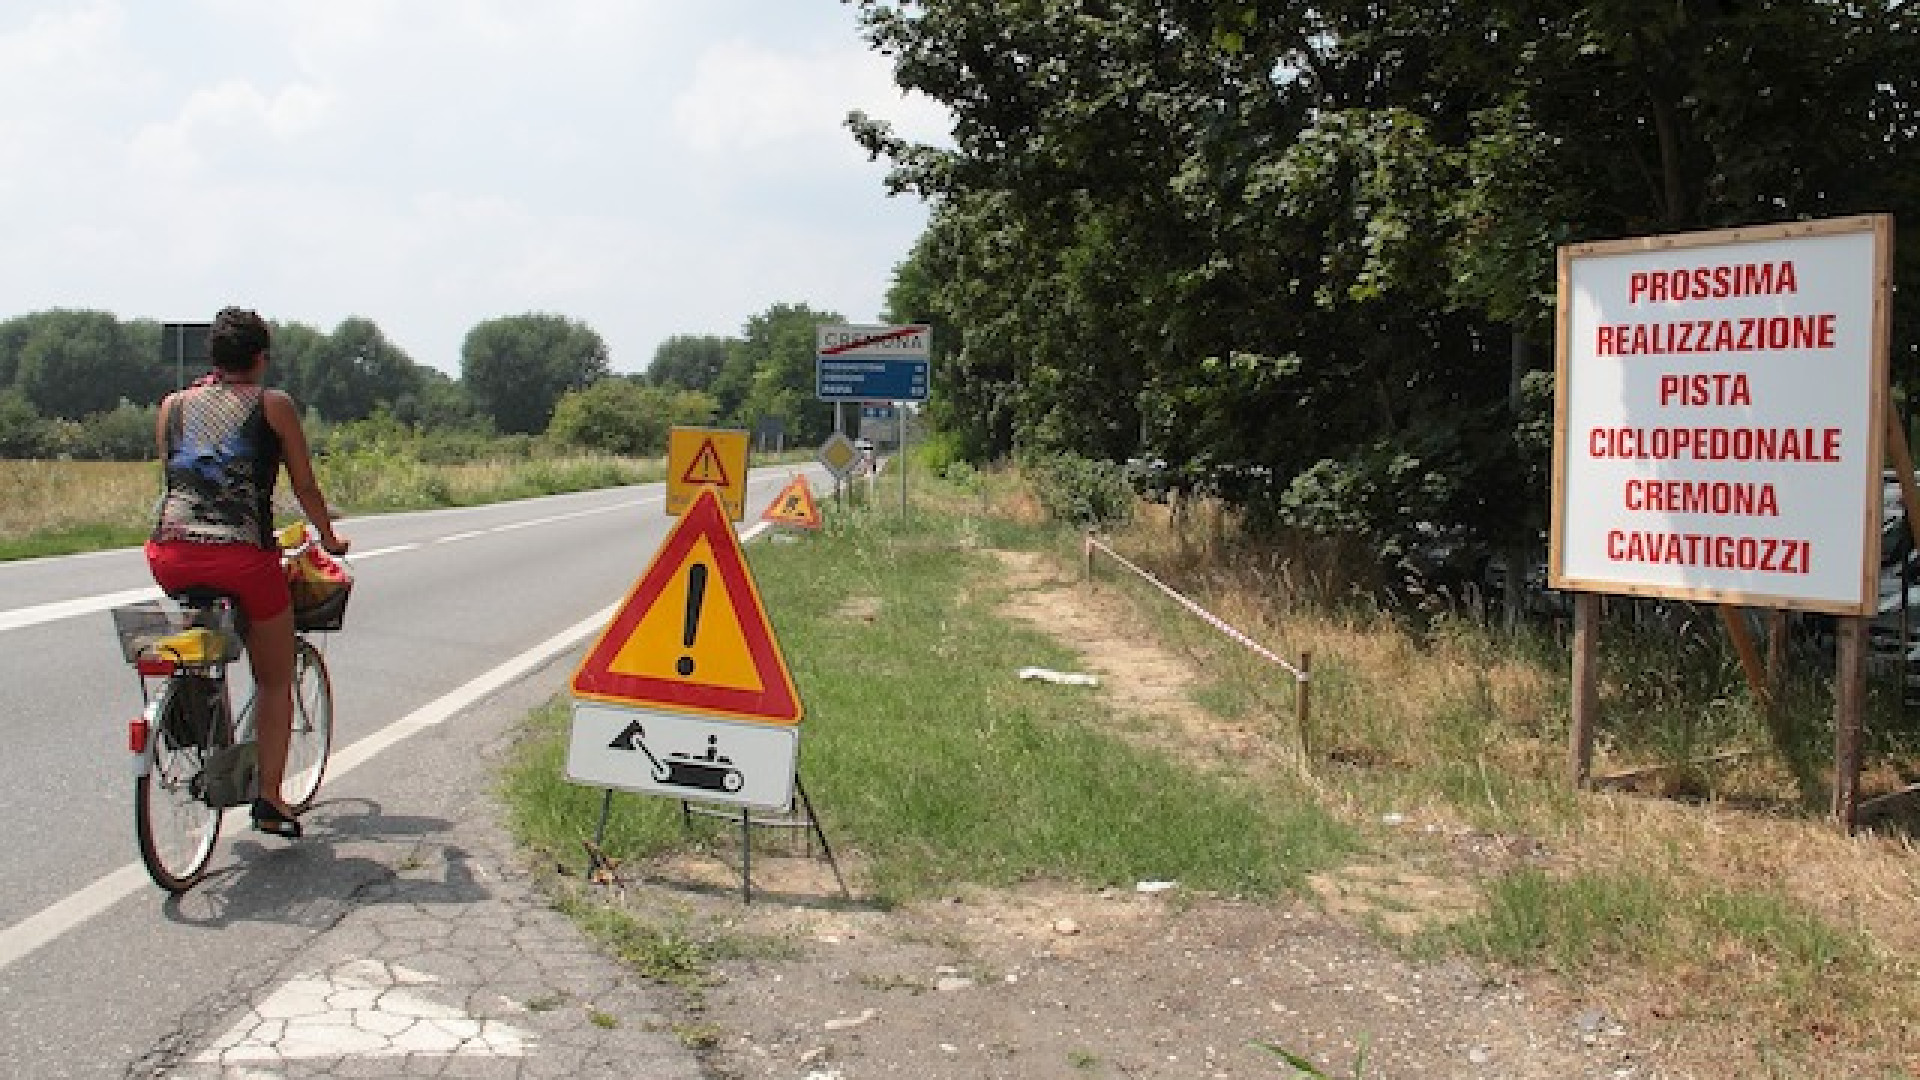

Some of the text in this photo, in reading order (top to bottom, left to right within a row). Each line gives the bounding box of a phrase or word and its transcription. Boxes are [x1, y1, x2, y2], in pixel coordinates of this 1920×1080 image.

[1629, 261, 1797, 304] PROSSIMA
[1596, 314, 1836, 357] REALIZZAZIONE
[1659, 373, 1752, 407] PISTA
[1589, 427, 1841, 462] CICLOPEDONALE
[1624, 479, 1779, 516] CREMONA
[1606, 530, 1812, 574] CAVATIGOZZI
